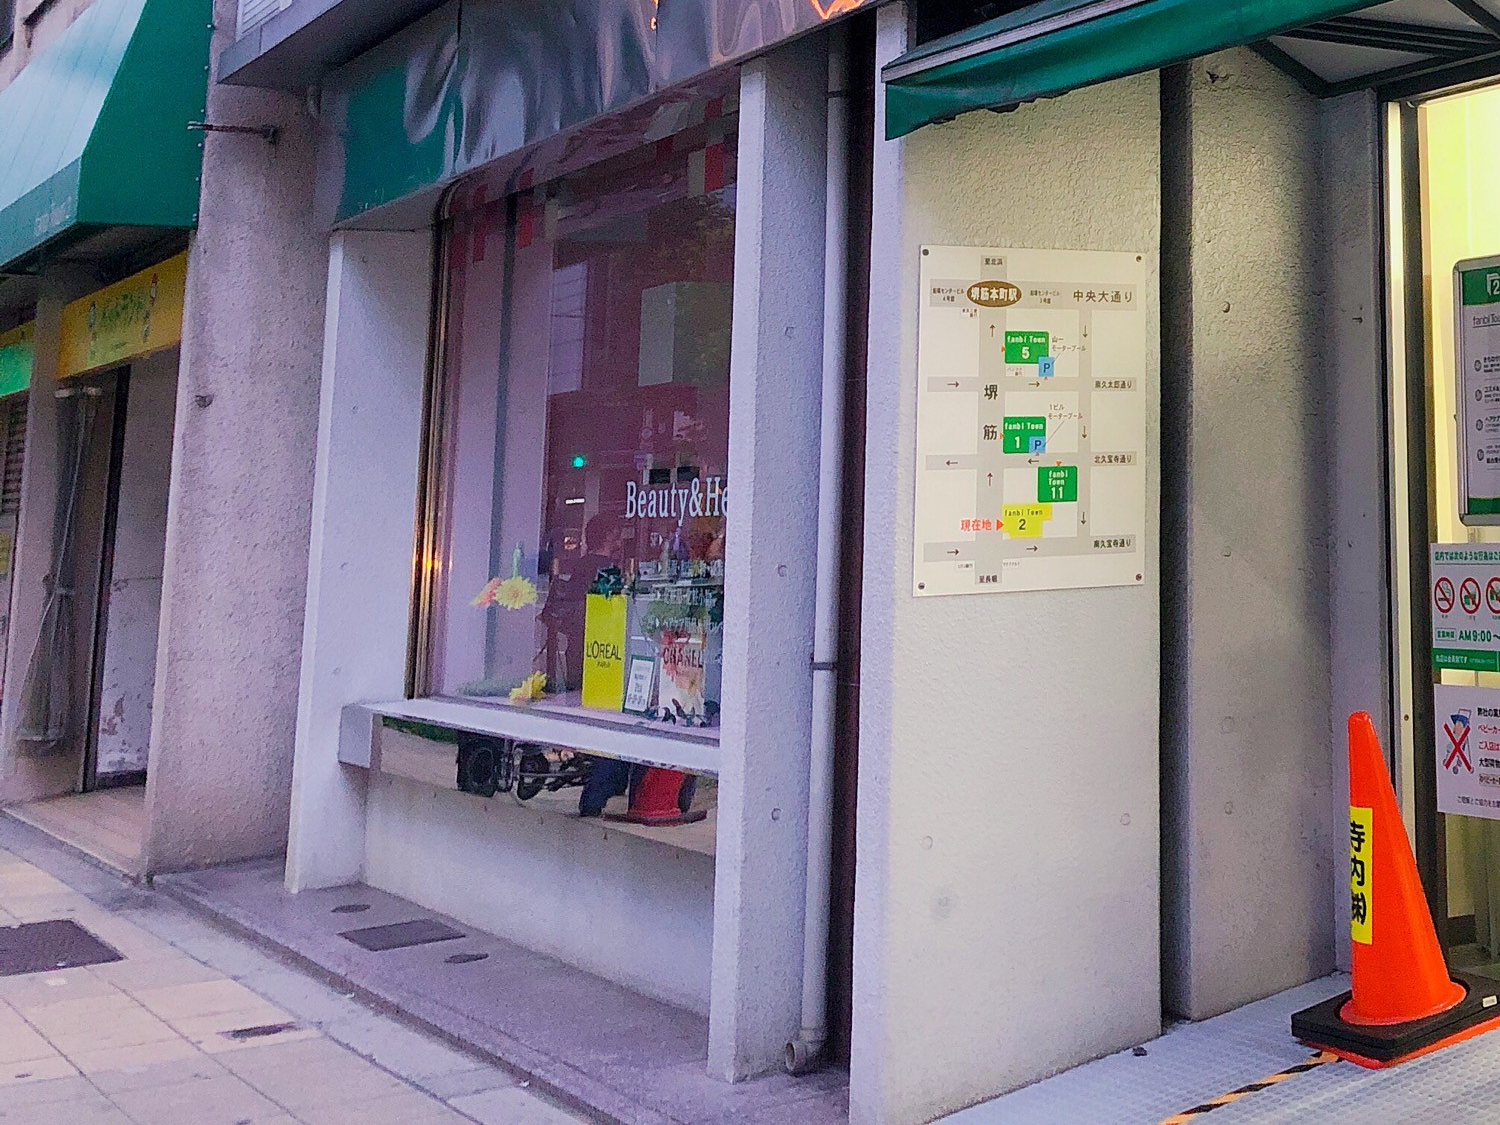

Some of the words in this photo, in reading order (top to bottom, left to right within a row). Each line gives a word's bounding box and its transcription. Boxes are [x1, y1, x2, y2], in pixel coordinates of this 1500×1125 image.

[1073, 289, 1133, 303] 中央大通り
[1021, 346, 1030, 359] 5
[1043, 362, 1051, 373] P
[1014, 436, 1021, 449] 1
[1034, 439, 1042, 451] P
[1051, 486, 1064, 499] 11
[1004, 509, 1024, 517] fanbi
[1026, 508, 1043, 516] Town
[960, 519, 992, 532] 現在地
[1018, 518, 1026, 530] 2
[663, 646, 704, 669] CHANEL
